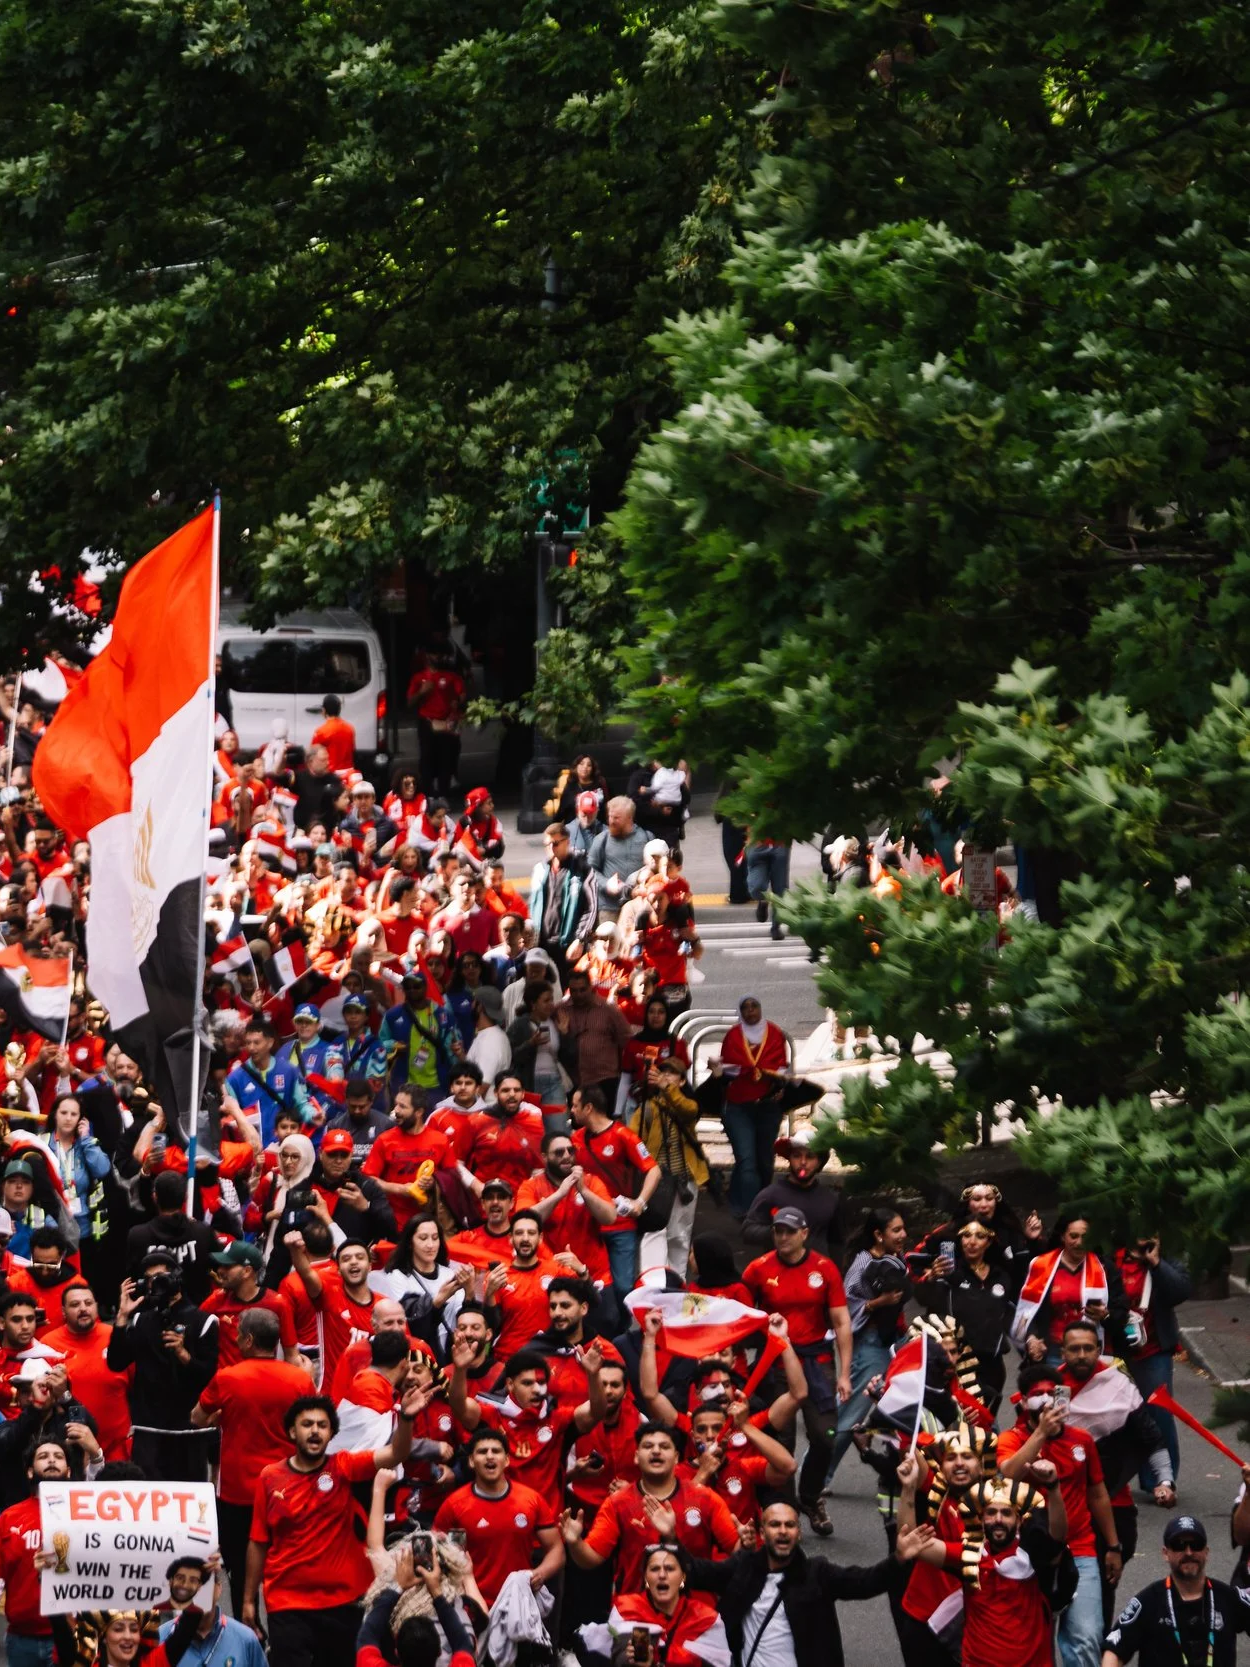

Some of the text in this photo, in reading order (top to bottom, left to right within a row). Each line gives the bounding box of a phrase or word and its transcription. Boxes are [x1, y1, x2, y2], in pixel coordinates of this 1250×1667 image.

[69, 1489, 195, 1523] EGYPT
[21, 1528, 41, 1550] 10
[85, 1533, 175, 1553] IS GONNA
[76, 1562, 153, 1580] WIN THE
[53, 1584, 163, 1602] WORLD CUP
